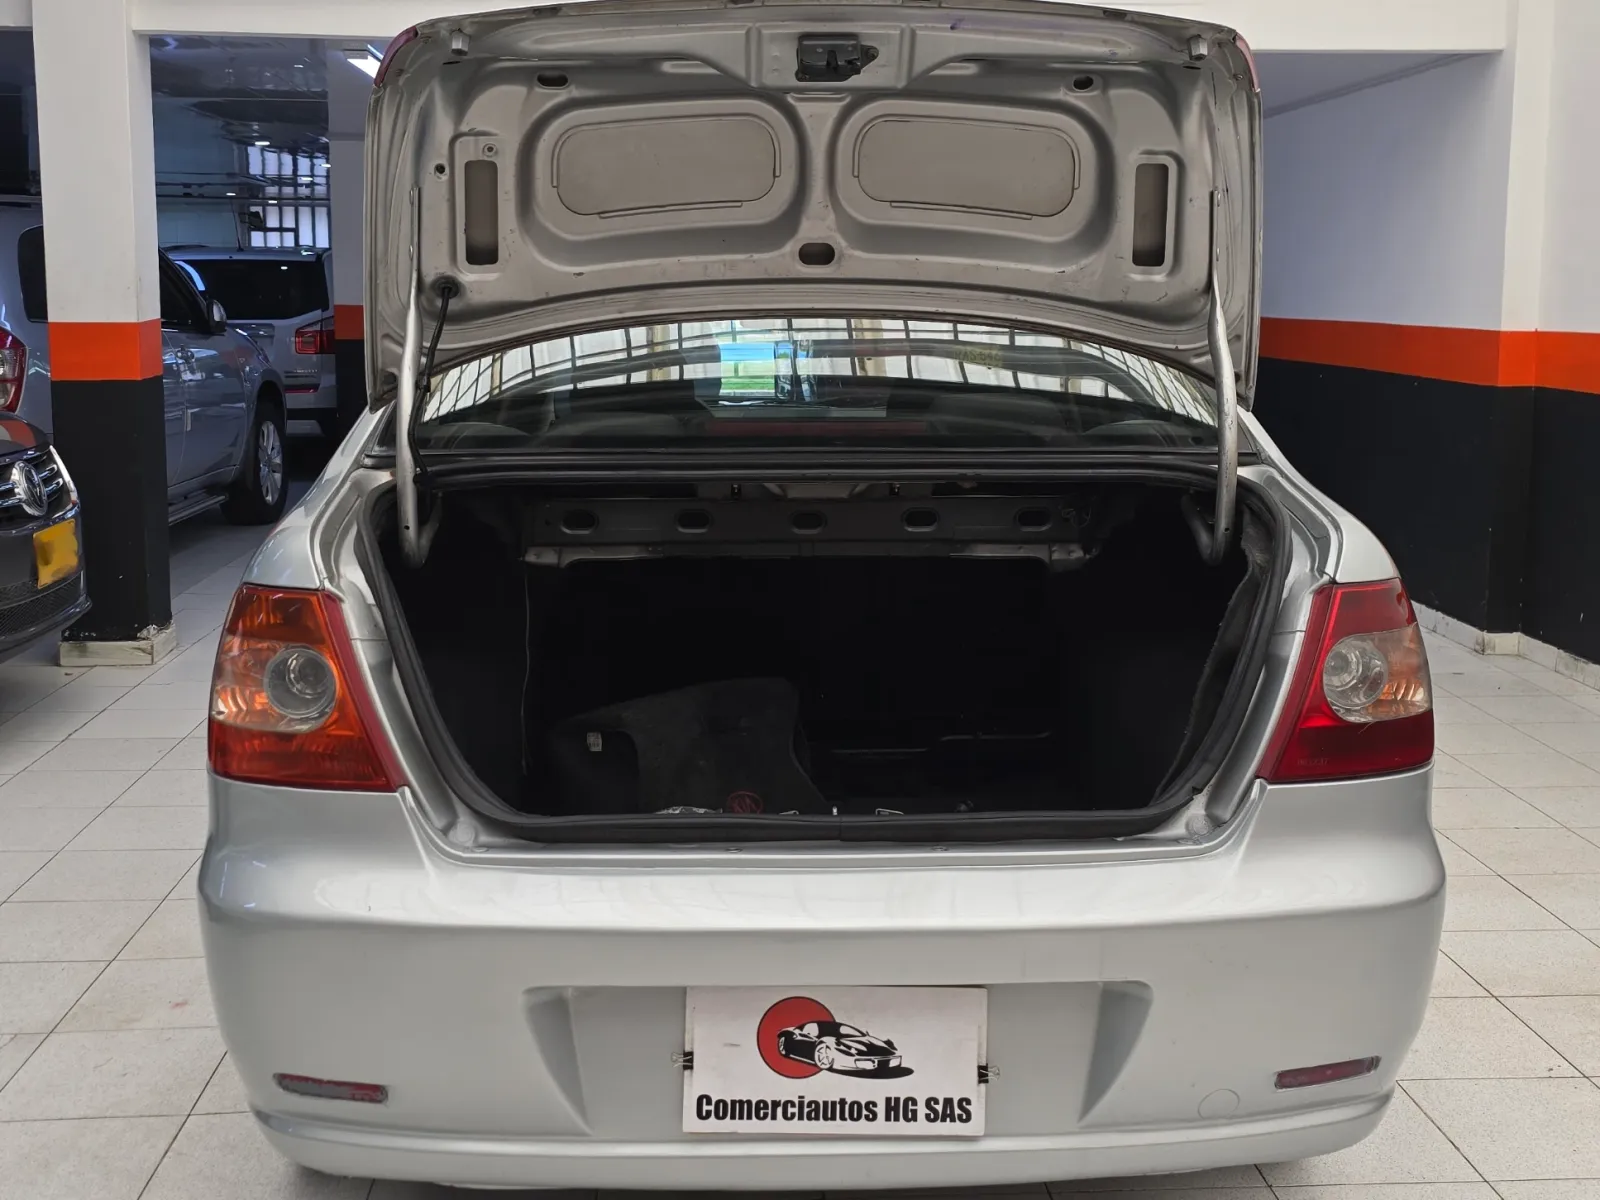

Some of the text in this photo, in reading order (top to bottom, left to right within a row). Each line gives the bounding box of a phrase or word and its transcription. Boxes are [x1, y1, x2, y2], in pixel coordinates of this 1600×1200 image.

[696, 1094, 972, 1123] Comerciautos HG SAS
